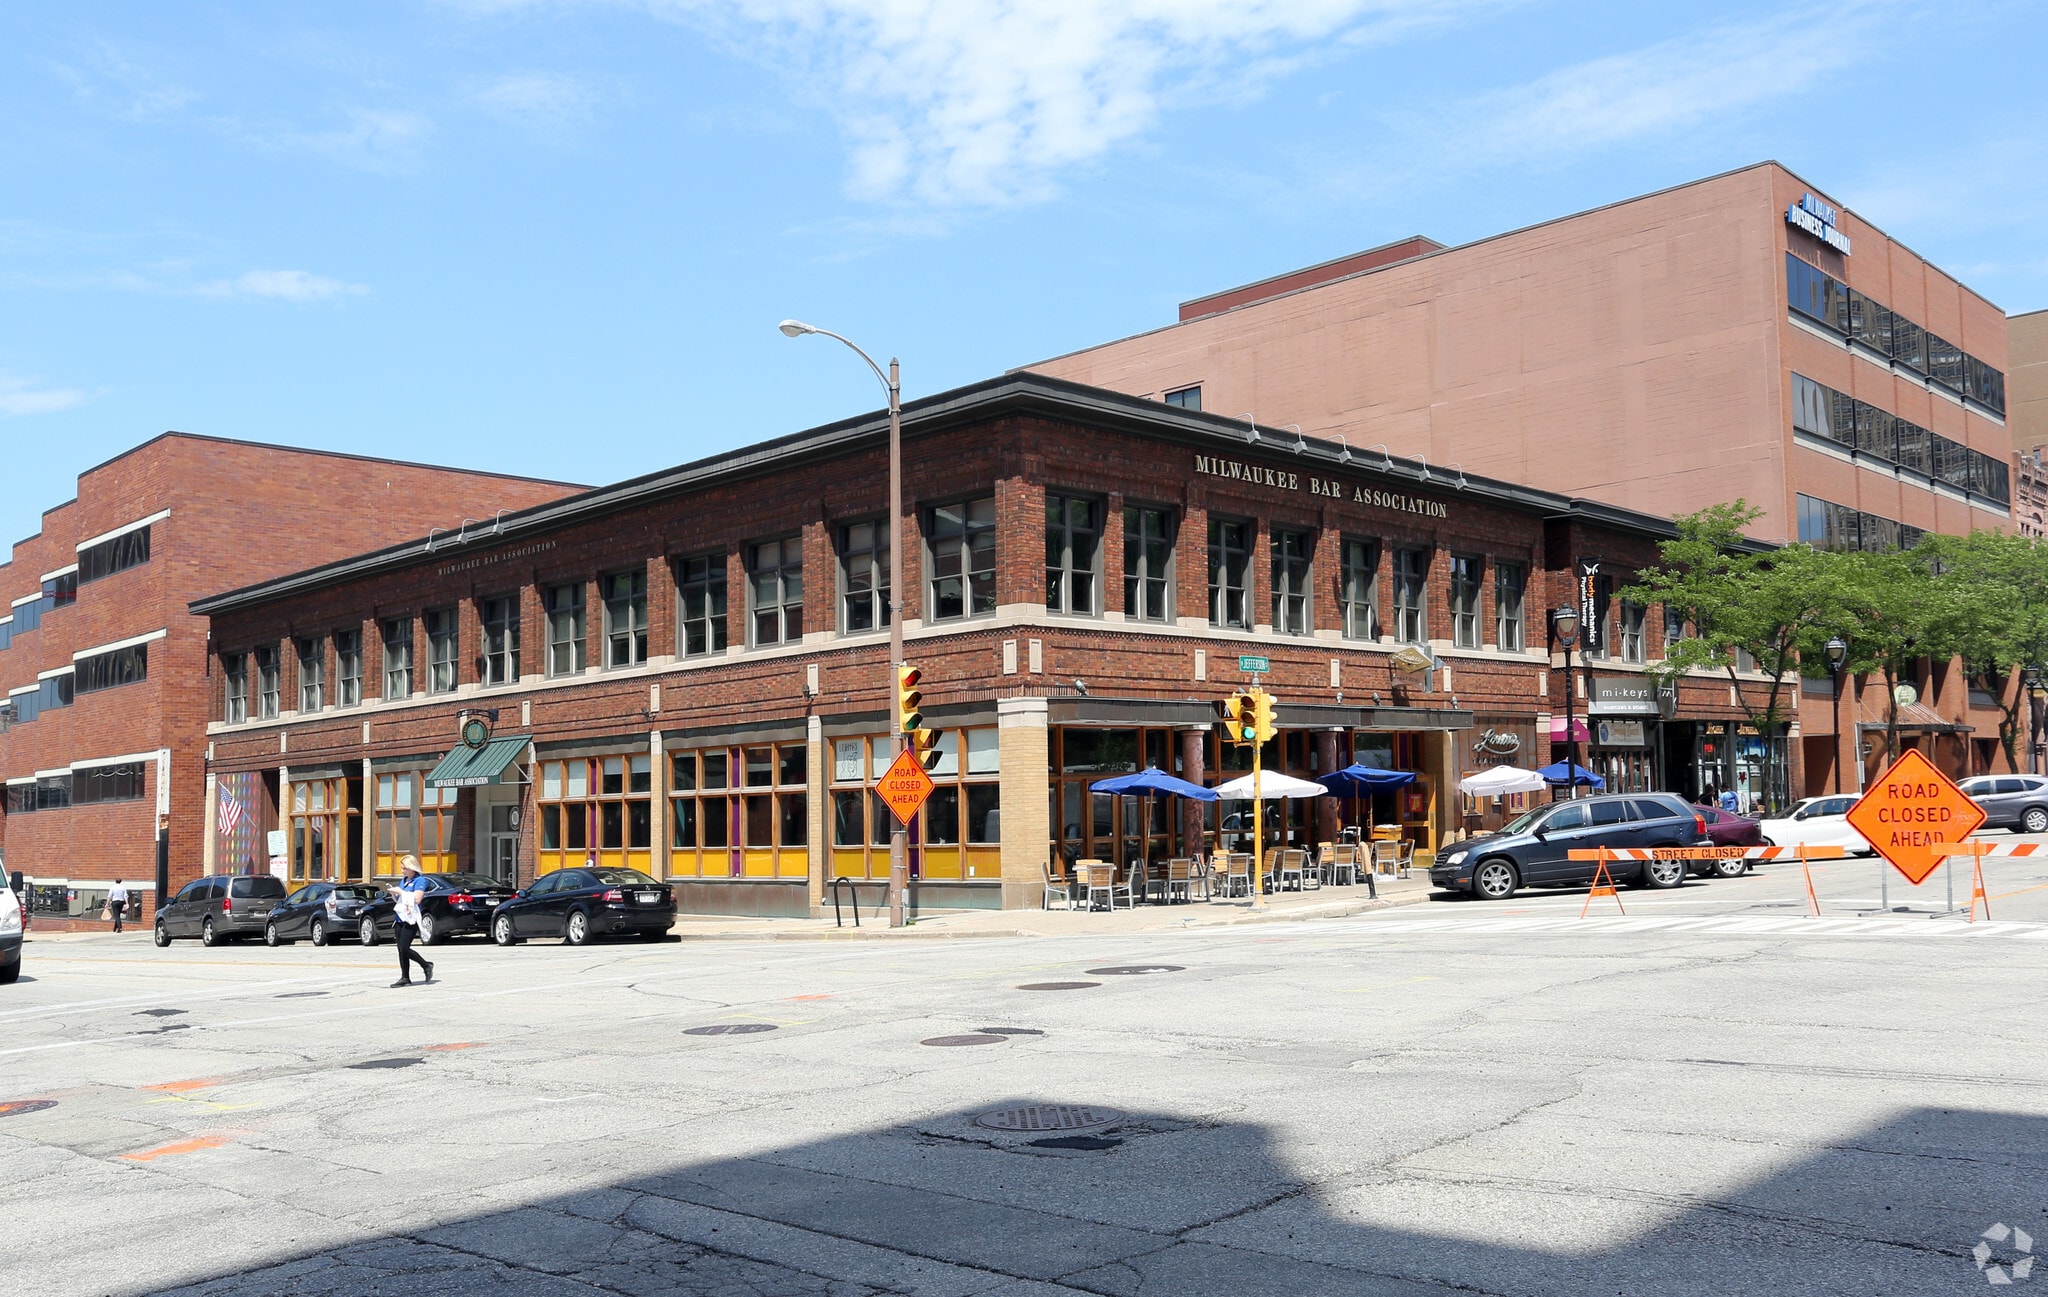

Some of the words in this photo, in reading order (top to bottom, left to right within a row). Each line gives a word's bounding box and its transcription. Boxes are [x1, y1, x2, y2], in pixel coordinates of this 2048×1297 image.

[1788, 204, 1823, 239] BUSINESS
[1194, 454, 1298, 491] MILWAUKEE
[1310, 477, 1341, 498] BAR
[1353, 487, 1447, 519] ASSOCIATION
[438, 559, 480, 576] MILWAUKEE
[484, 554, 498, 565] BAR
[503, 540, 556, 561] ASSOCIATION
[1243, 658, 1266, 670] JEFFERSON
[894, 768, 917, 777] ROAD
[434, 779, 456, 788] MILWAUKEE
[456, 778, 464, 786] BAR
[464, 776, 489, 786] ASSOCIATION
[889, 780, 921, 790] CLOSED
[1888, 783, 1939, 799] ROAD
[892, 794, 919, 804] AHEAD
[1878, 807, 1950, 823] CLOSED
[1890, 831, 1944, 847] AHEAD
[1652, 849, 1694, 860] STREET
[1702, 847, 1745, 859] CLOSED
